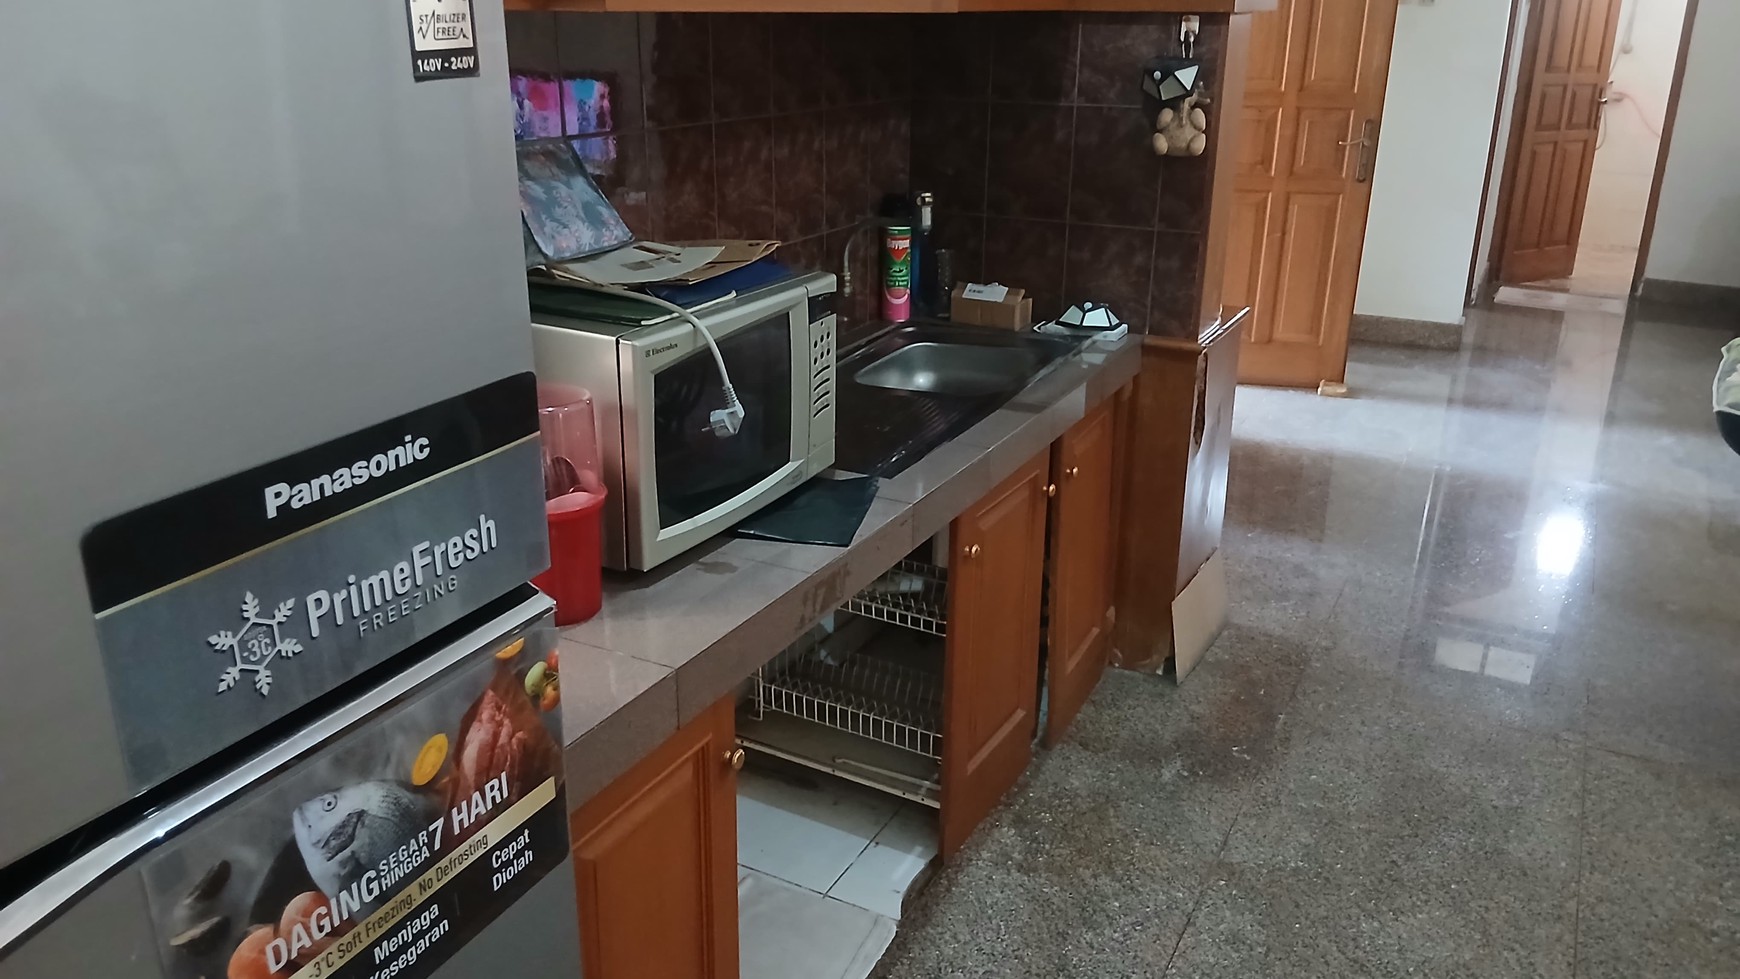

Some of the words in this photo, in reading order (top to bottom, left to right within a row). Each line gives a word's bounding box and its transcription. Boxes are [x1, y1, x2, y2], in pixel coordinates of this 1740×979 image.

[436, 26, 457, 37] FREE
[417, 58, 442, 73] 140V
[450, 55, 475, 70] 240V
[263, 434, 431, 520] Panasonic
[306, 514, 498, 638] PrimeFresh
[358, 574, 459, 638] FREEZING
[428, 816, 445, 851] 7
[451, 770, 509, 836] HARI
[379, 830, 429, 877] SEGAR
[381, 845, 431, 892] HINGGA
[491, 828, 531, 869] Cepat
[492, 848, 534, 892] Diolah
[265, 868, 381, 976] DAGING
[338, 931, 363, 960] Soft
[365, 894, 417, 940] Freezing.
[419, 876, 434, 897] No
[436, 833, 488, 883] Defrosting
[373, 903, 440, 965] Menjaga
